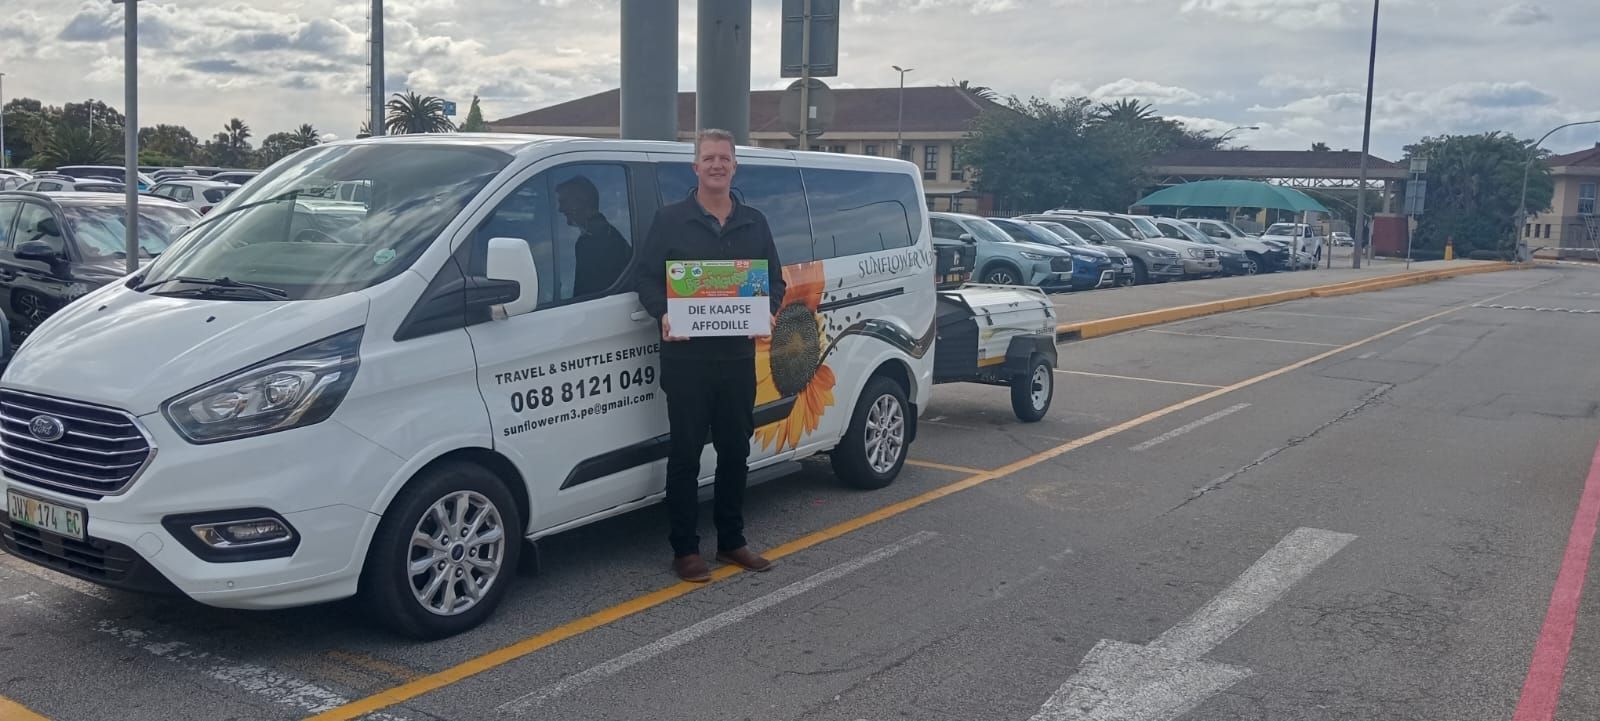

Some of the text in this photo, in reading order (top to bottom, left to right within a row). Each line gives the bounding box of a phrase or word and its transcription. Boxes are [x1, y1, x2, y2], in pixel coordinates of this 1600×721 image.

[859, 250, 922, 278] SUNFLOWER
[688, 304, 751, 315] DIE KAAPSE
[692, 320, 749, 331] AFFODILLE
[495, 343, 659, 385] TRAVEL & SHUTTLE SERVICE
[511, 366, 655, 413] 068 8121 049
[504, 392, 654, 437] sunflowerm3.pe@gmail.com
[38, 503, 58, 529] 174
[66, 511, 81, 535] EC
